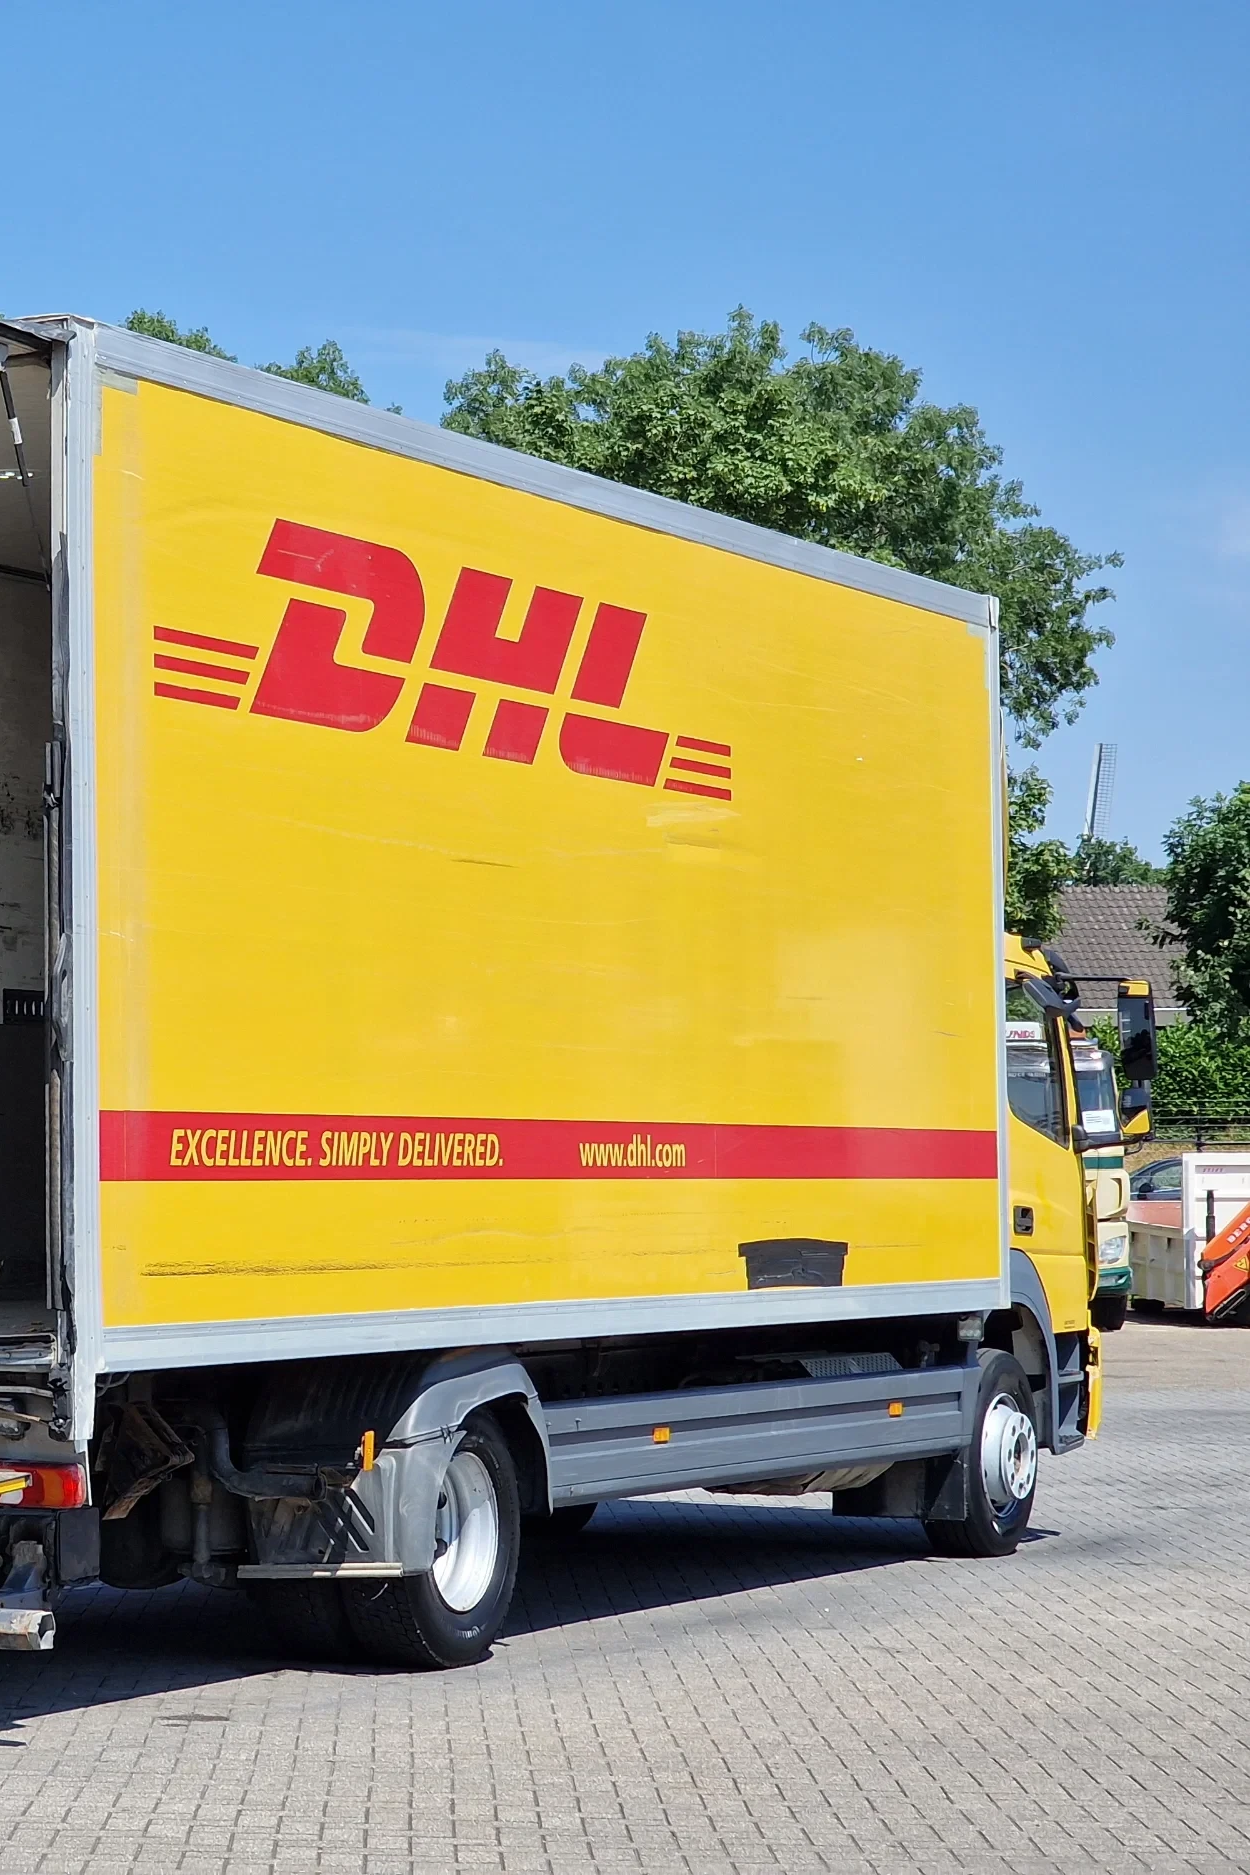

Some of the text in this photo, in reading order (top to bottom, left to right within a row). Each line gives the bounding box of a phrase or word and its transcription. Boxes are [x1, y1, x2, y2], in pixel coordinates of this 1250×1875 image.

[249, 518, 669, 787] DHL
[169, 1128, 505, 1167] EXCELLENCE. SIMPLY DELIVERED.
[578, 1133, 687, 1168] www.dhl.com
